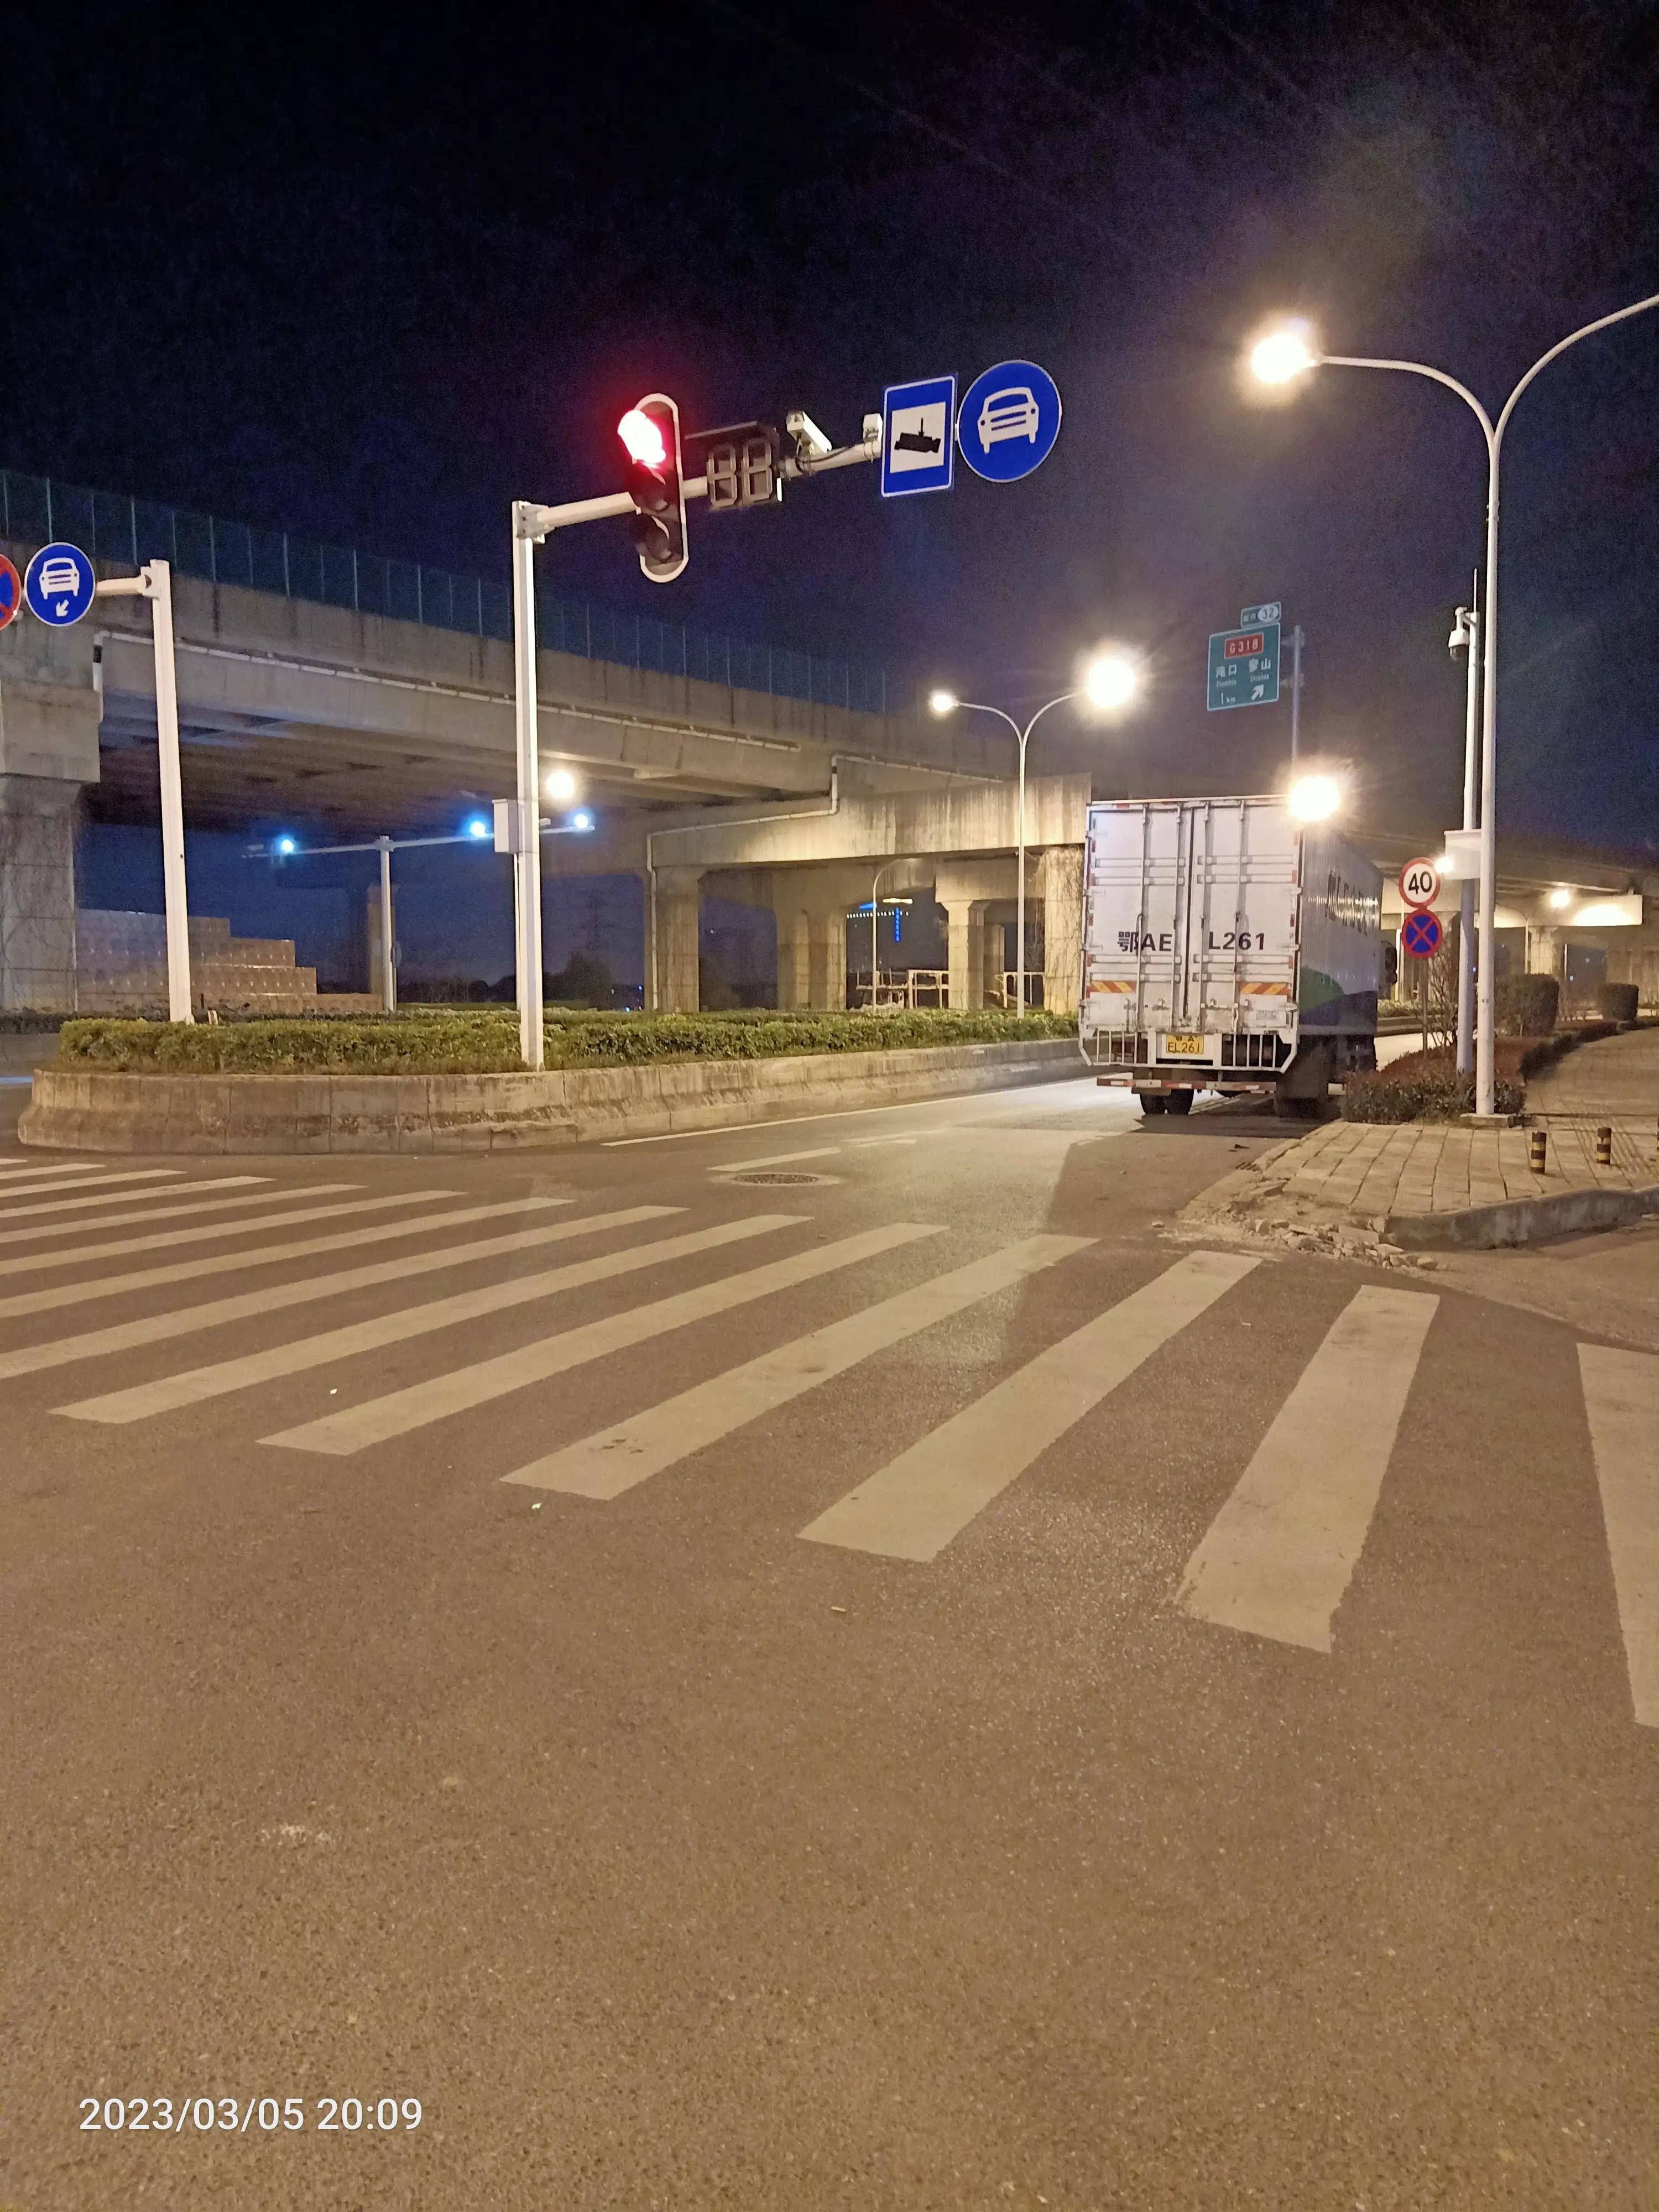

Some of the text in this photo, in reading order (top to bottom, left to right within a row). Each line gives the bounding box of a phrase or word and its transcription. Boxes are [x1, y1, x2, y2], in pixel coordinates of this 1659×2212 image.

[1229, 638, 1259, 654] G318
[1408, 871, 1432, 895] 40
[1209, 931, 1265, 951] L261
[1167, 1042, 1199, 1053] EL261
